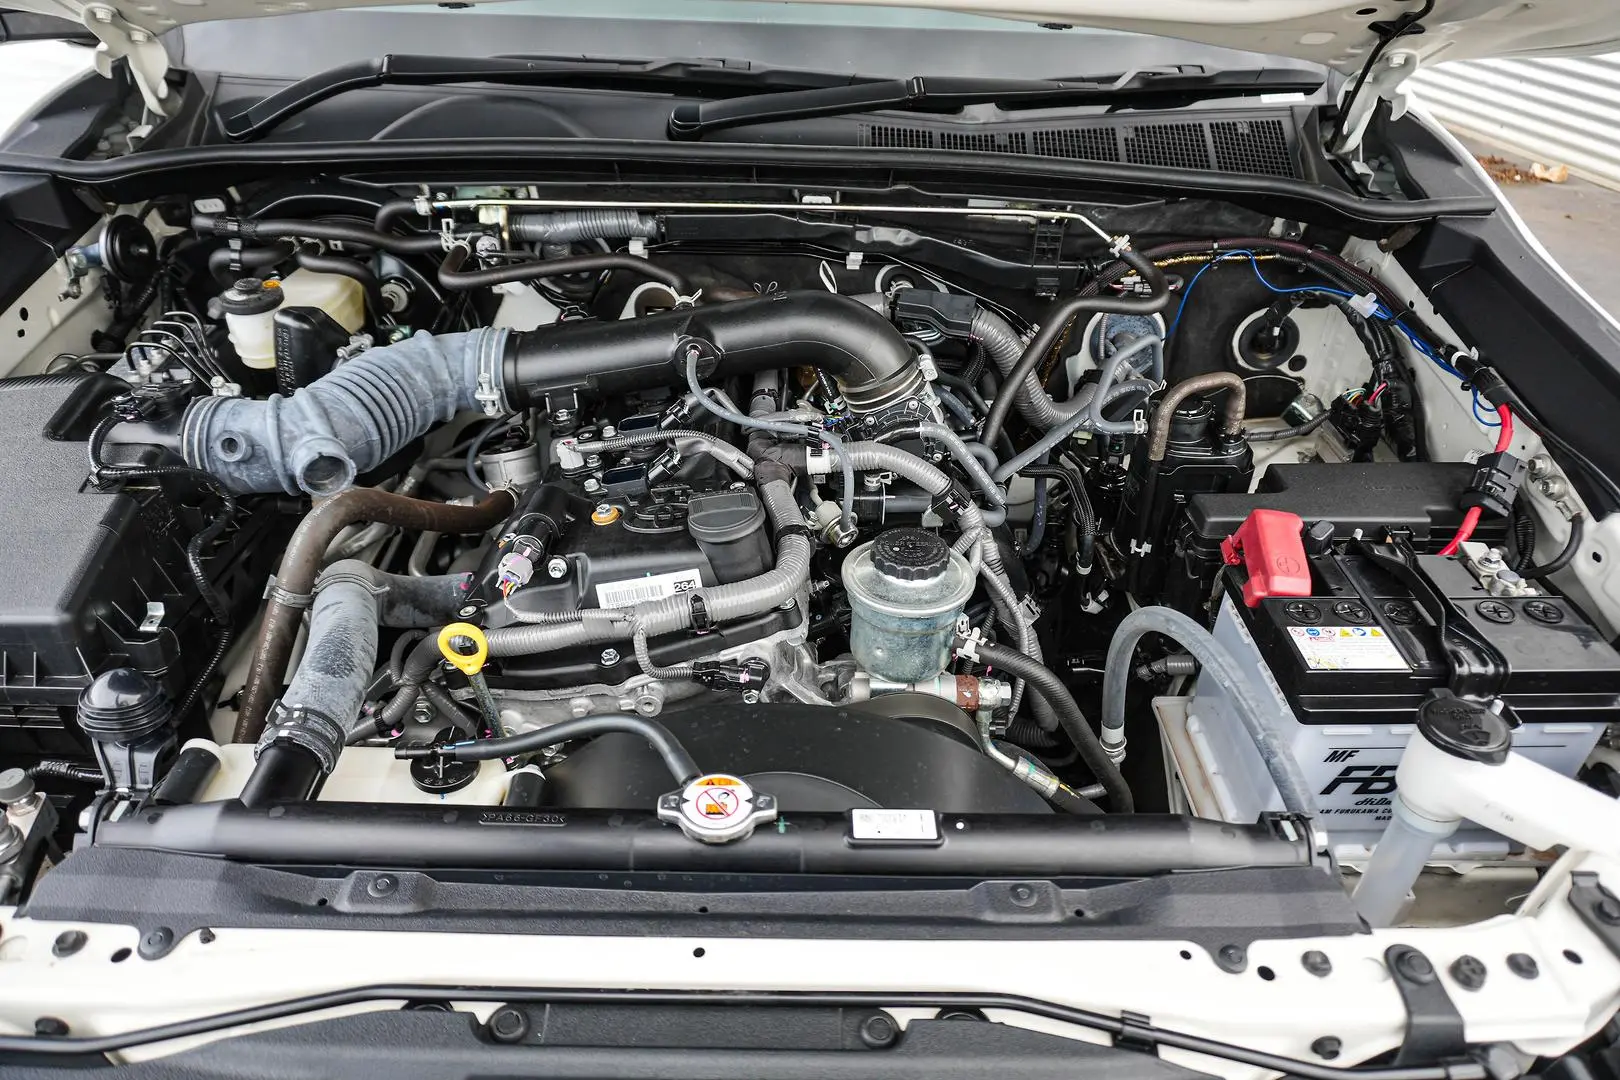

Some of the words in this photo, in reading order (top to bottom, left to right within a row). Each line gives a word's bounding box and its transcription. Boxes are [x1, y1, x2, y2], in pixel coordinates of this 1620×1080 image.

[674, 580, 696, 592] 264
[1323, 750, 1360, 763] MF
[1319, 765, 1398, 795] FB
